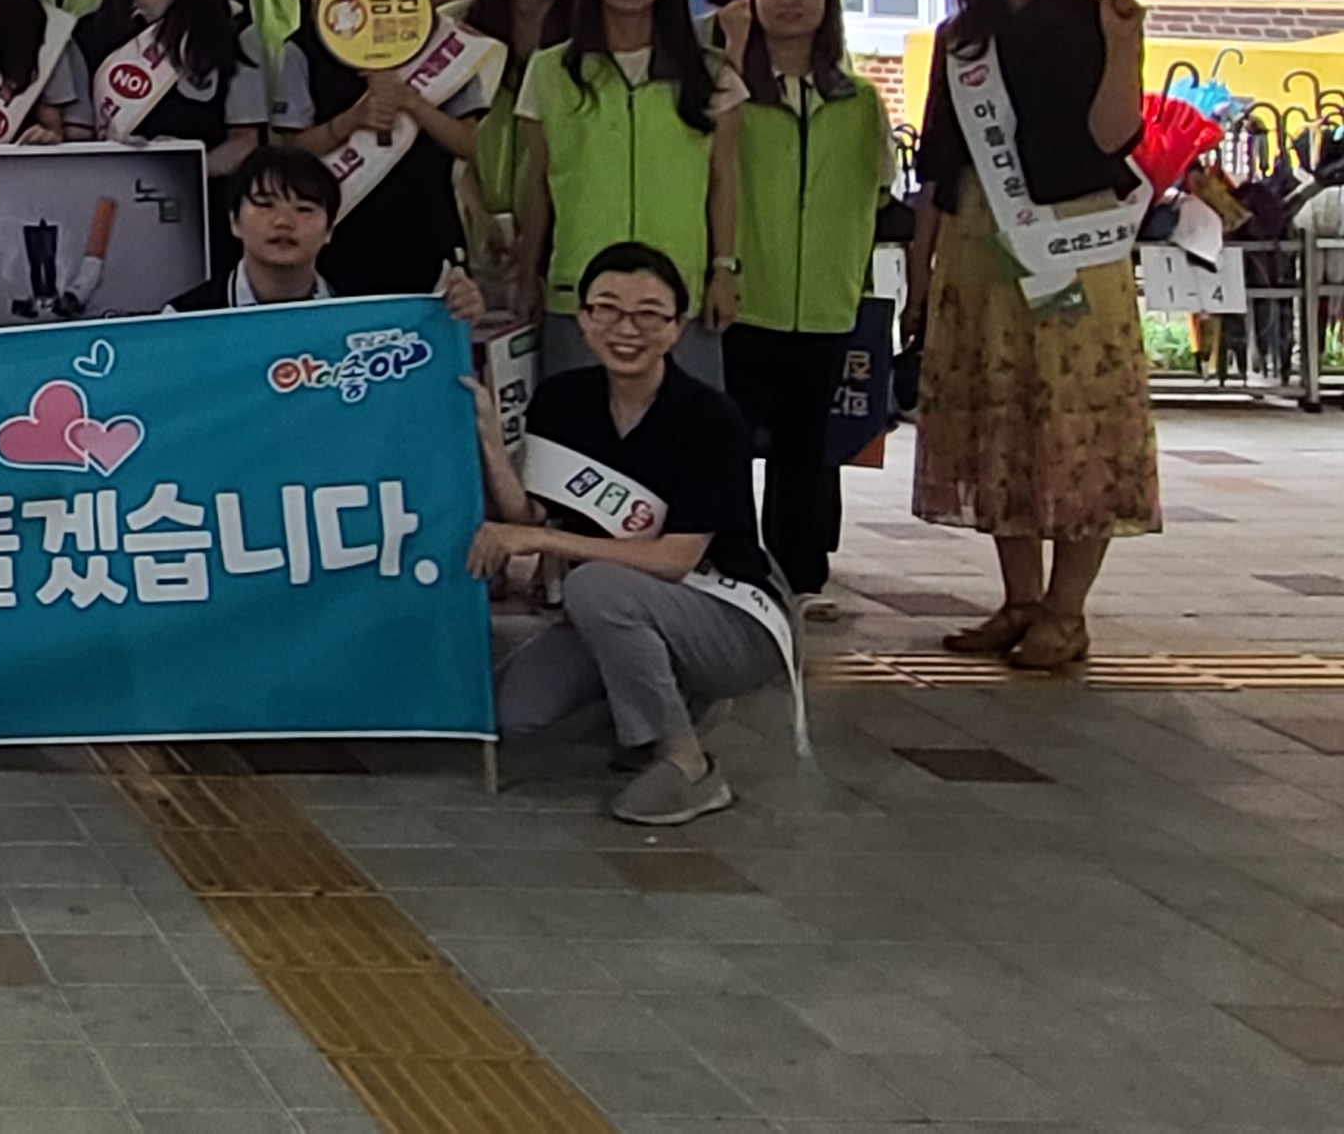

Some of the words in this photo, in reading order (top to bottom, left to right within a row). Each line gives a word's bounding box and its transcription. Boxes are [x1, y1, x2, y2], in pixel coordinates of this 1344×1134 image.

[112, 69, 150, 95] NO!
[974, 99, 1028, 199] 아름다운
[268, 340, 432, 403] 아이좋아
